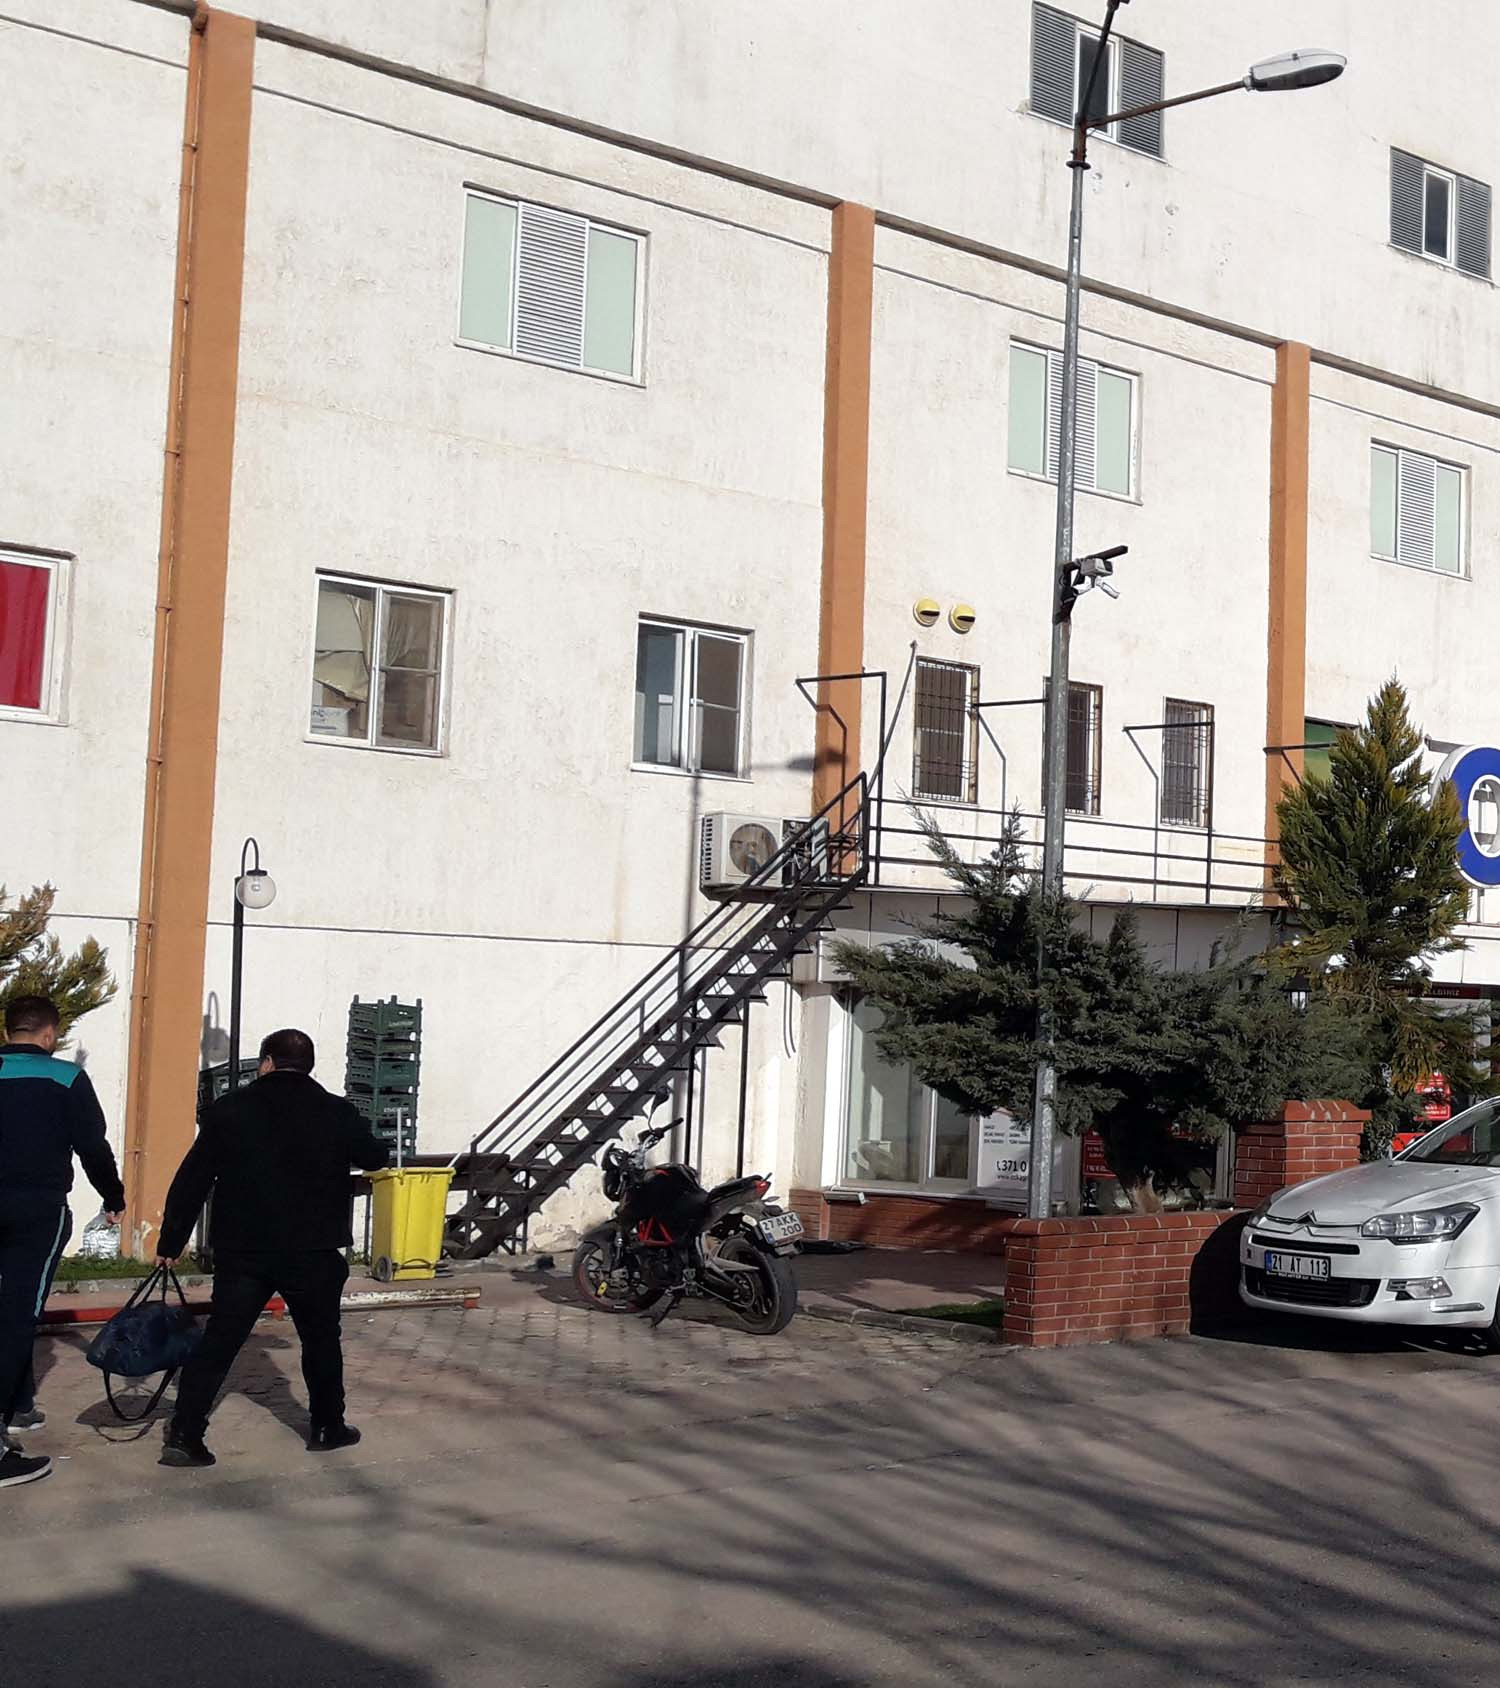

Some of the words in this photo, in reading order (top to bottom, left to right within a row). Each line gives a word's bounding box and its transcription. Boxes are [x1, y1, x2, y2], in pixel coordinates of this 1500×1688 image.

[1001, 1159, 1018, 1173] 371
[762, 1220, 775, 1231] 27
[776, 1213, 798, 1227] AKK
[781, 1223, 802, 1236] 200
[1272, 1254, 1282, 1270] 21
[1290, 1256, 1301, 1273] AT
[1310, 1259, 1329, 1276] 113
